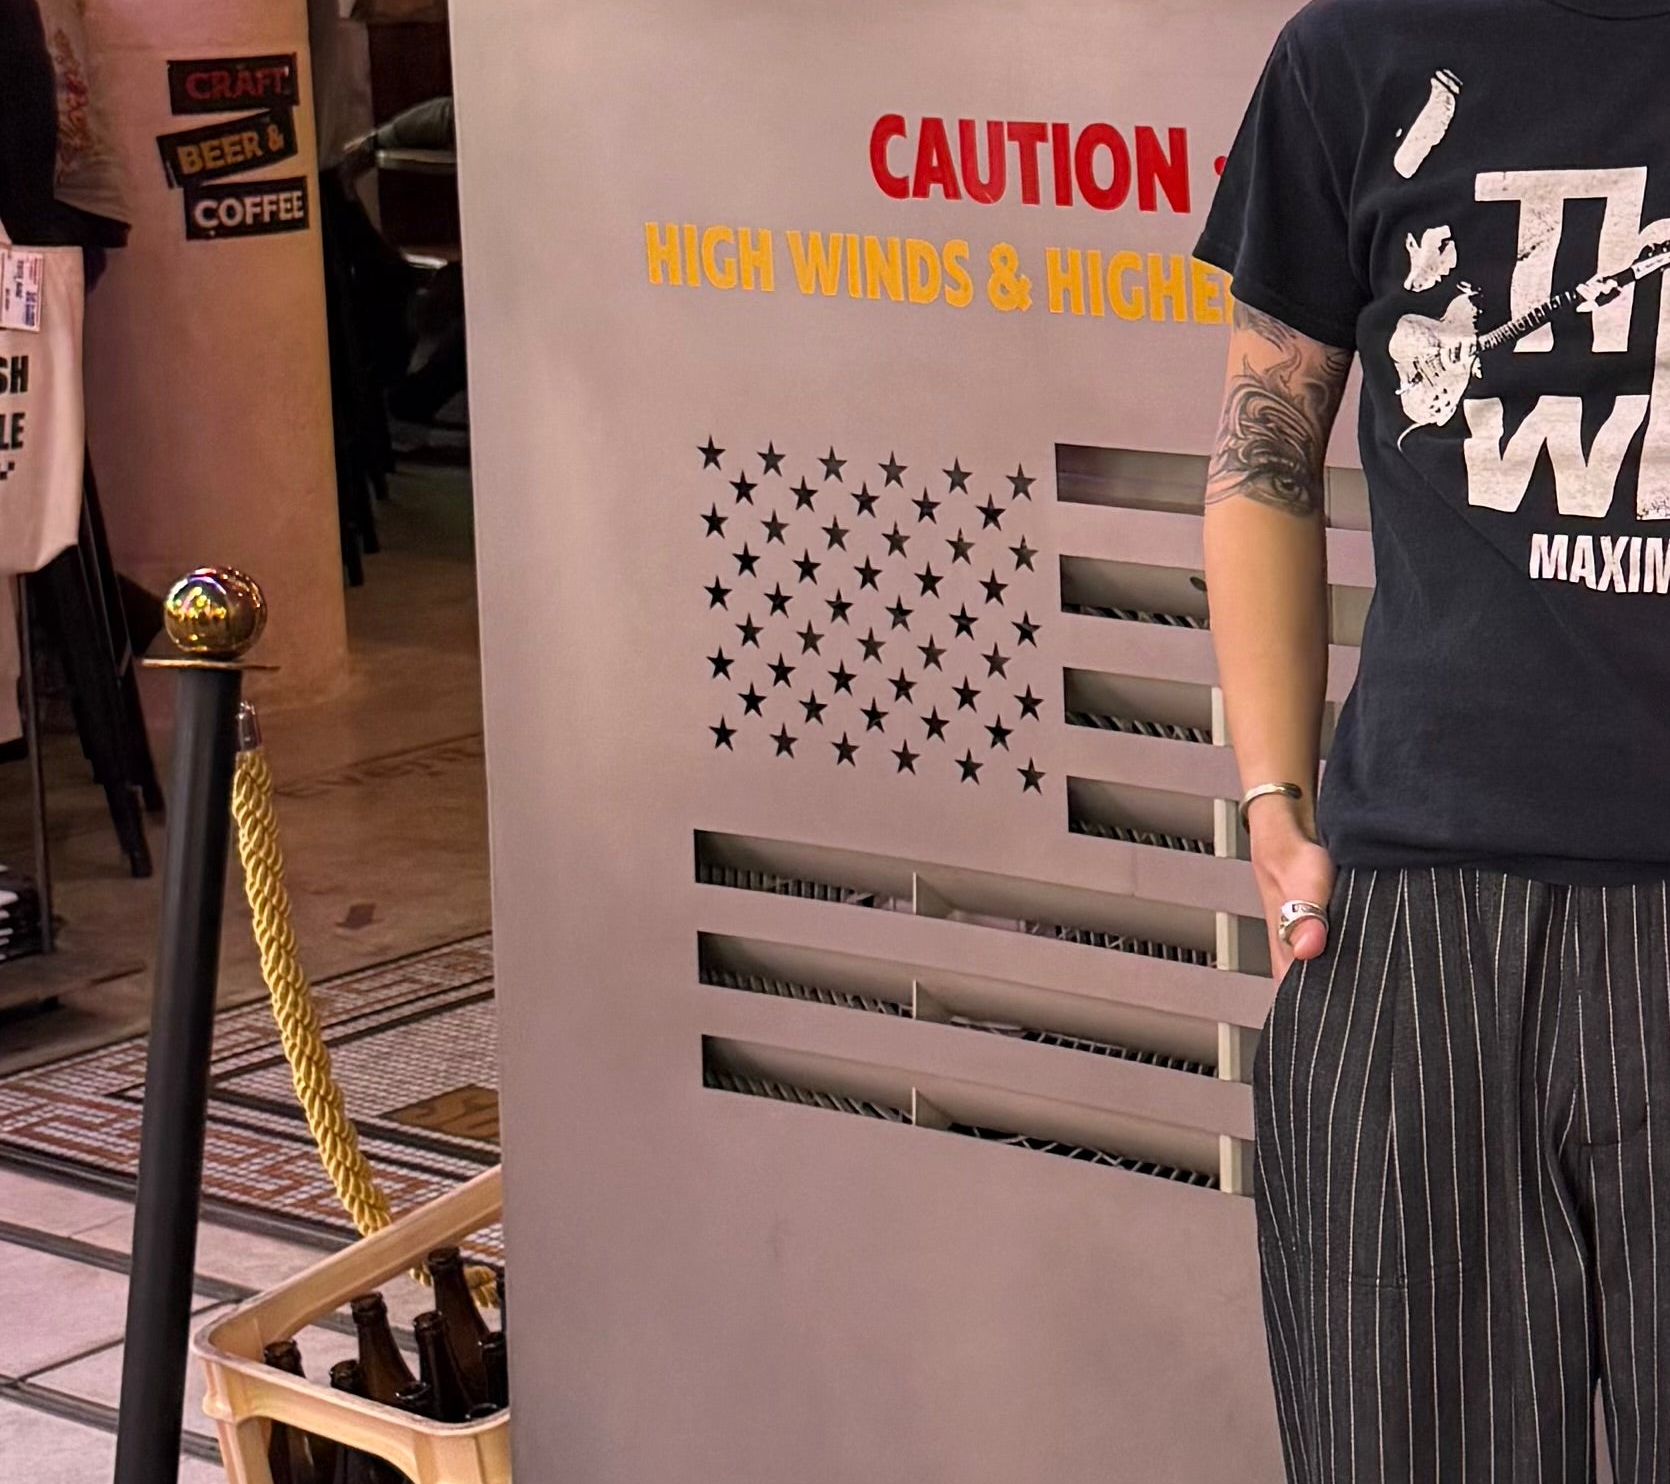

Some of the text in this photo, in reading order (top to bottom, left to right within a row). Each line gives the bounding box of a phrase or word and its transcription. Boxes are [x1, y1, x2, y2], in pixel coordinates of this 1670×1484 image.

[185, 67, 289, 99] CRAFT
[177, 124, 284, 175] BEER &
[869, 113, 1191, 213] CAUTION
[194, 191, 304, 228] COFFEE
[645, 223, 774, 292] HIGH
[787, 229, 972, 308] WINDS
[988, 243, 1033, 314] &
